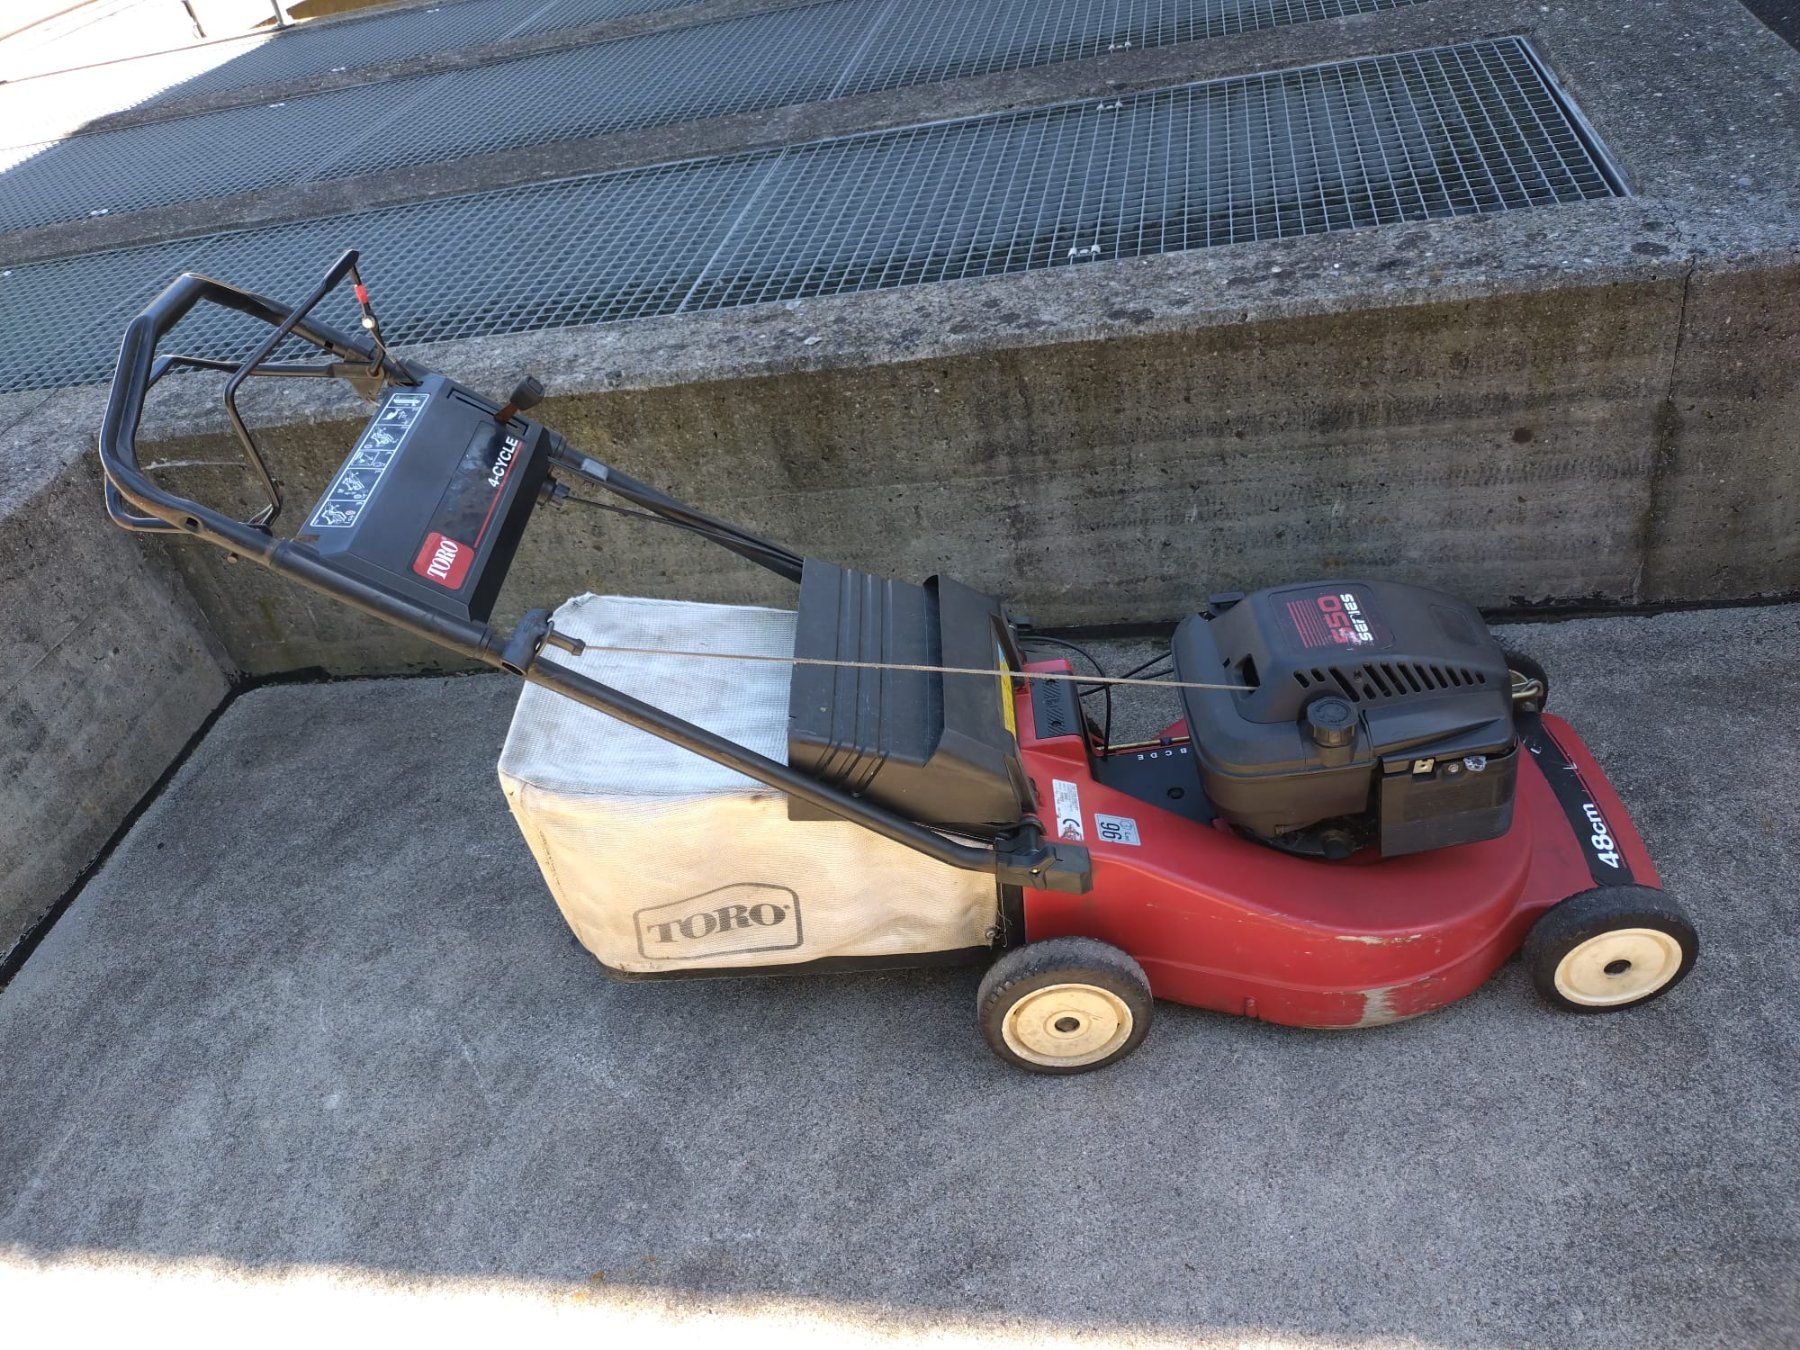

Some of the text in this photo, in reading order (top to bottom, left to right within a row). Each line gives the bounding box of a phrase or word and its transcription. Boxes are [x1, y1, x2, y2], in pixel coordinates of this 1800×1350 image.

[488, 435, 518, 488] 4-CYCLE
[427, 539, 459, 579] TORO
[1100, 821, 1122, 841] 96
[1583, 803, 1620, 869] 48cm
[647, 903, 787, 943] TORO
